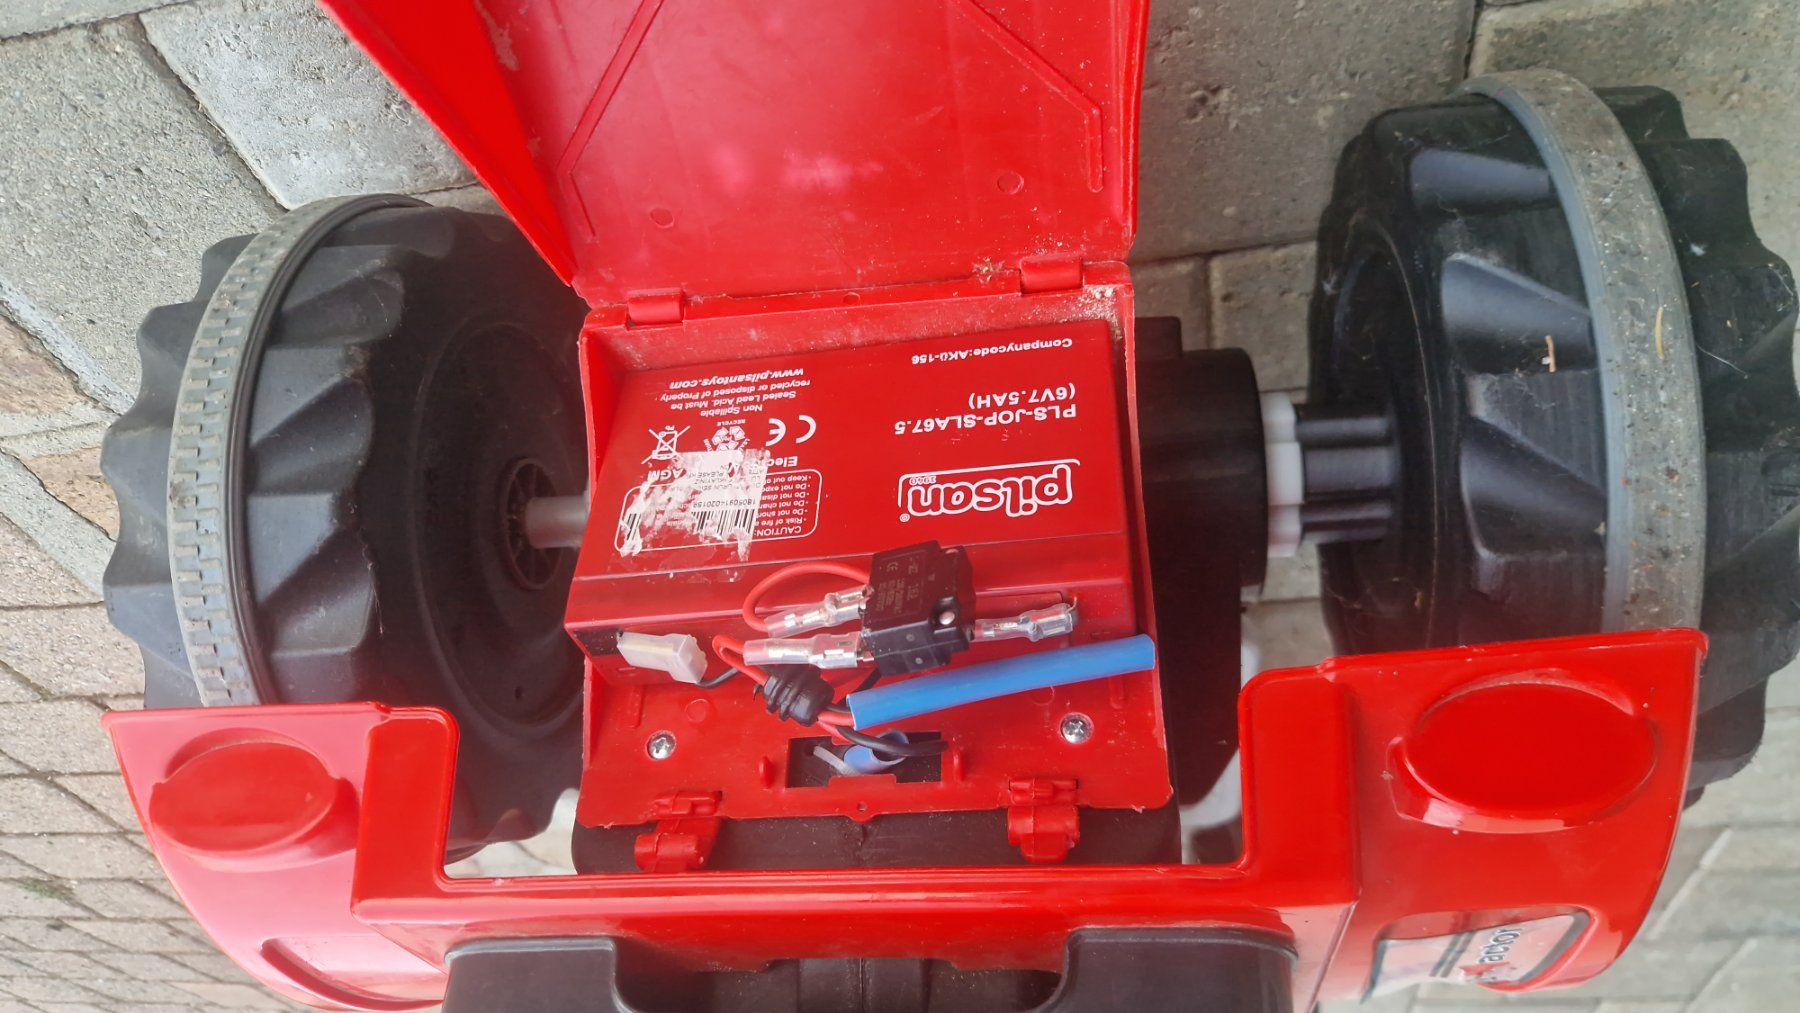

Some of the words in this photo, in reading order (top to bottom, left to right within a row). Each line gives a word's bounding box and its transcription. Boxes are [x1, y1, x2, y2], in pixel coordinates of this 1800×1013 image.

[669, 368, 804, 389] www.pilsantoys.com
[770, 380, 811, 391] recycled
[701, 390, 712, 398] of
[713, 386, 756, 397] disposed
[763, 391, 797, 401] Sealed
[968, 382, 1076, 410] (6V7.5AH)
[659, 391, 700, 402] Properly
[712, 396, 735, 405] Acid.
[736, 394, 760, 403] Lead
[670, 403, 683, 411] be
[684, 400, 709, 409] Must
[743, 404, 763, 412] Non
[700, 405, 740, 417] Spillable
[717, 419, 746, 427] RECYCLE
[894, 404, 1077, 435] PLS-JOP-SLA67.5
[787, 475, 808, 484] Keep
[907, 463, 1073, 517] pilsan
[775, 517, 785, 525] of
[786, 516, 803, 524] Risk
[753, 525, 802, 537] CAUTION:
